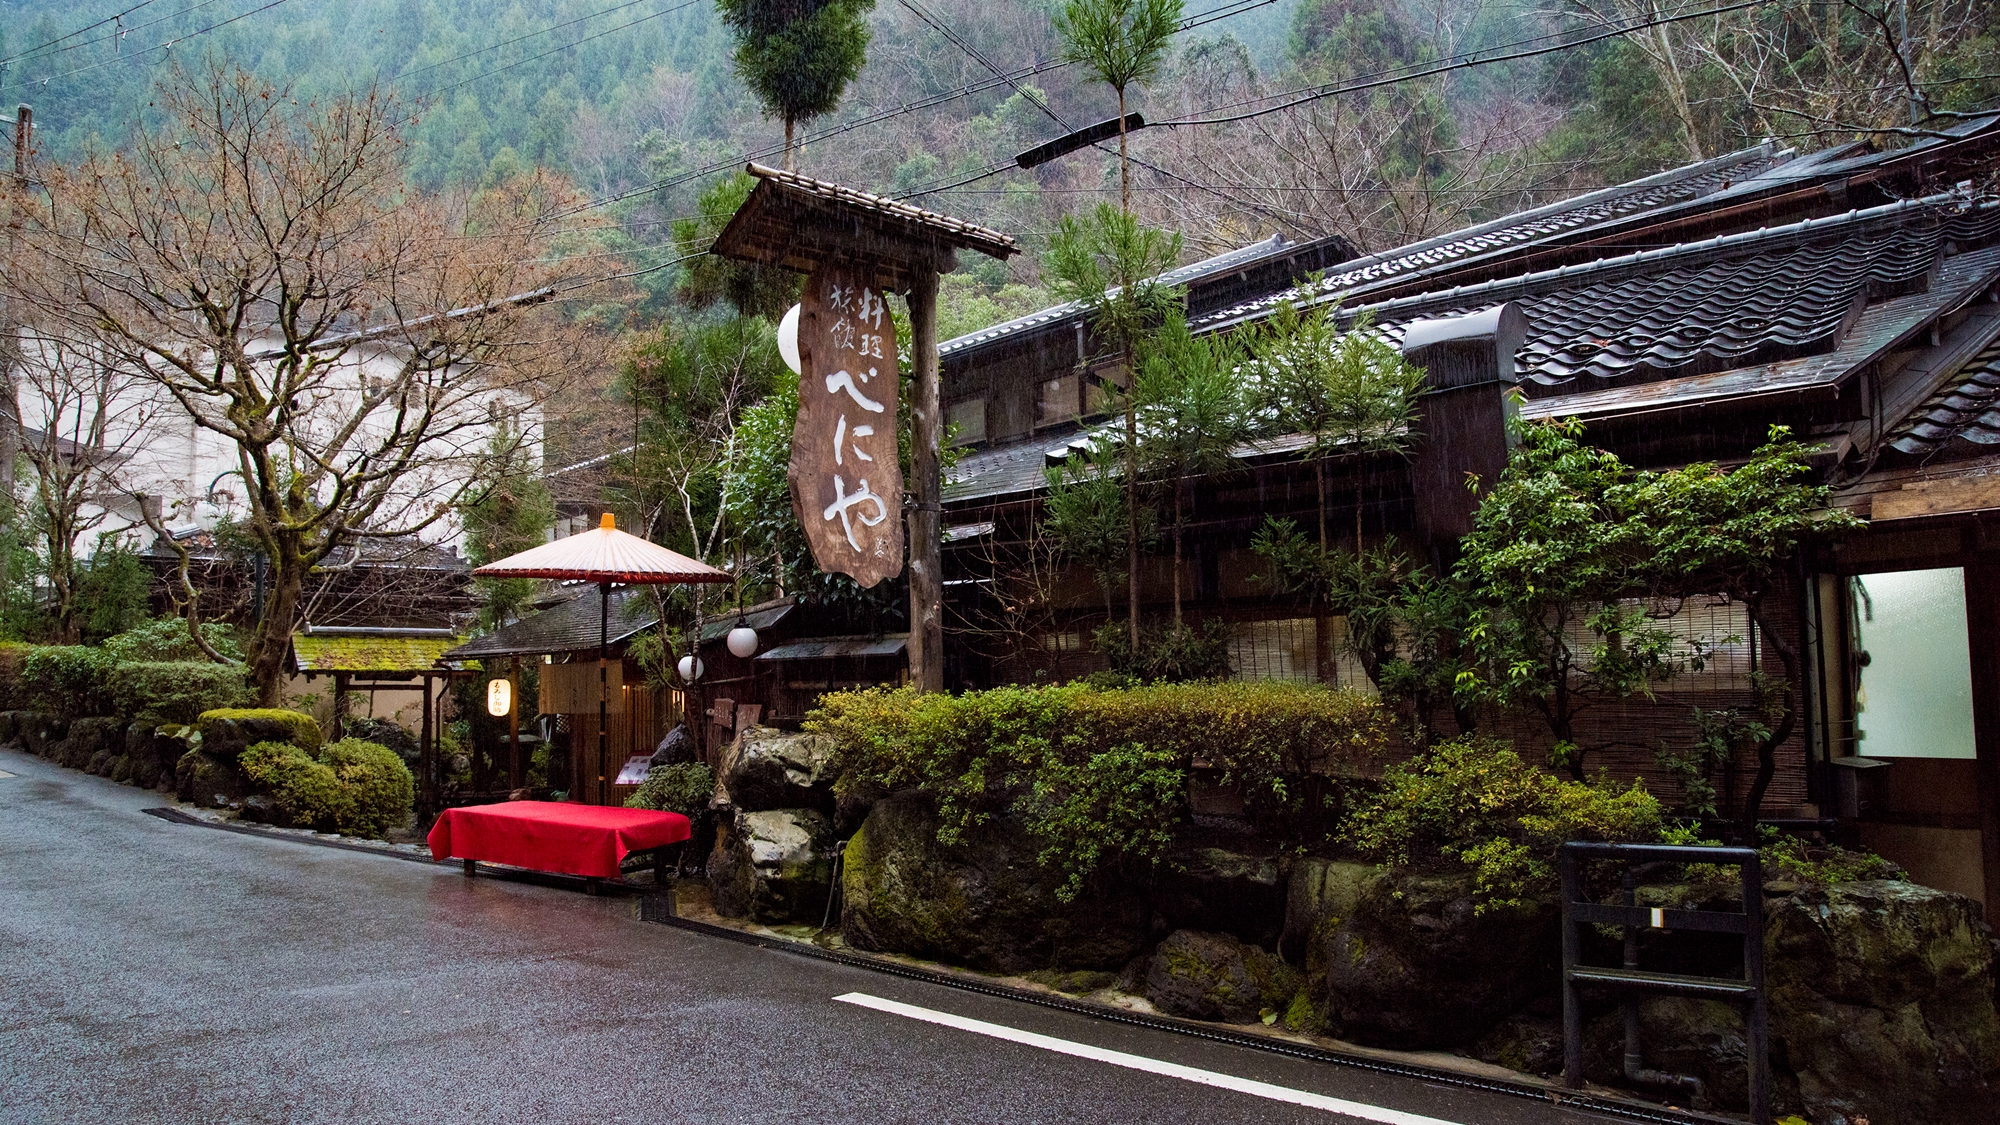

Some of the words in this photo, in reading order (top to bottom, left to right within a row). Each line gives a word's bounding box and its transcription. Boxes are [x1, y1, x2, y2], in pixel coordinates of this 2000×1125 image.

[858, 286, 885, 360] 料理
[823, 367, 888, 553] べにや
